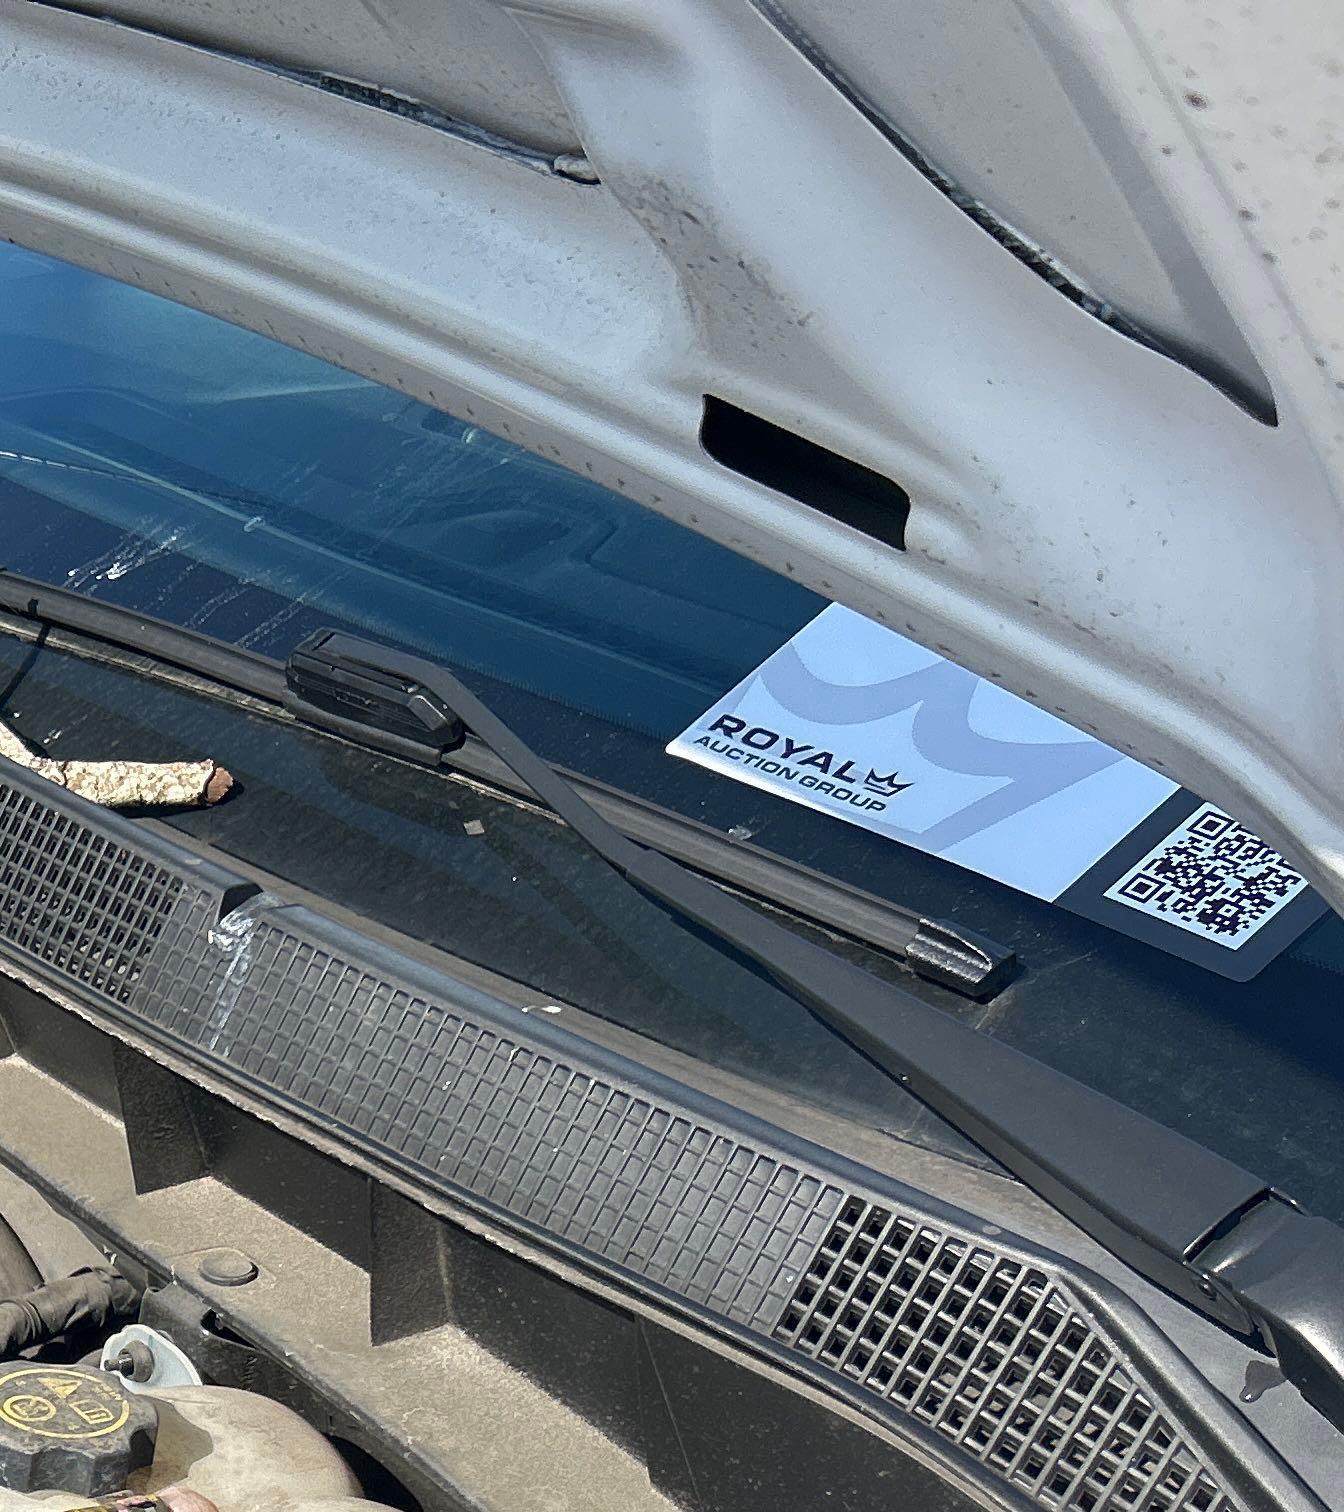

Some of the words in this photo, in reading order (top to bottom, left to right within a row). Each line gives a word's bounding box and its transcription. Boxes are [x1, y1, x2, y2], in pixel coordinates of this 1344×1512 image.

[693, 736, 800, 781] AUCTION
[799, 775, 887, 812] GROUP
[708, 714, 856, 784] ROYAL
